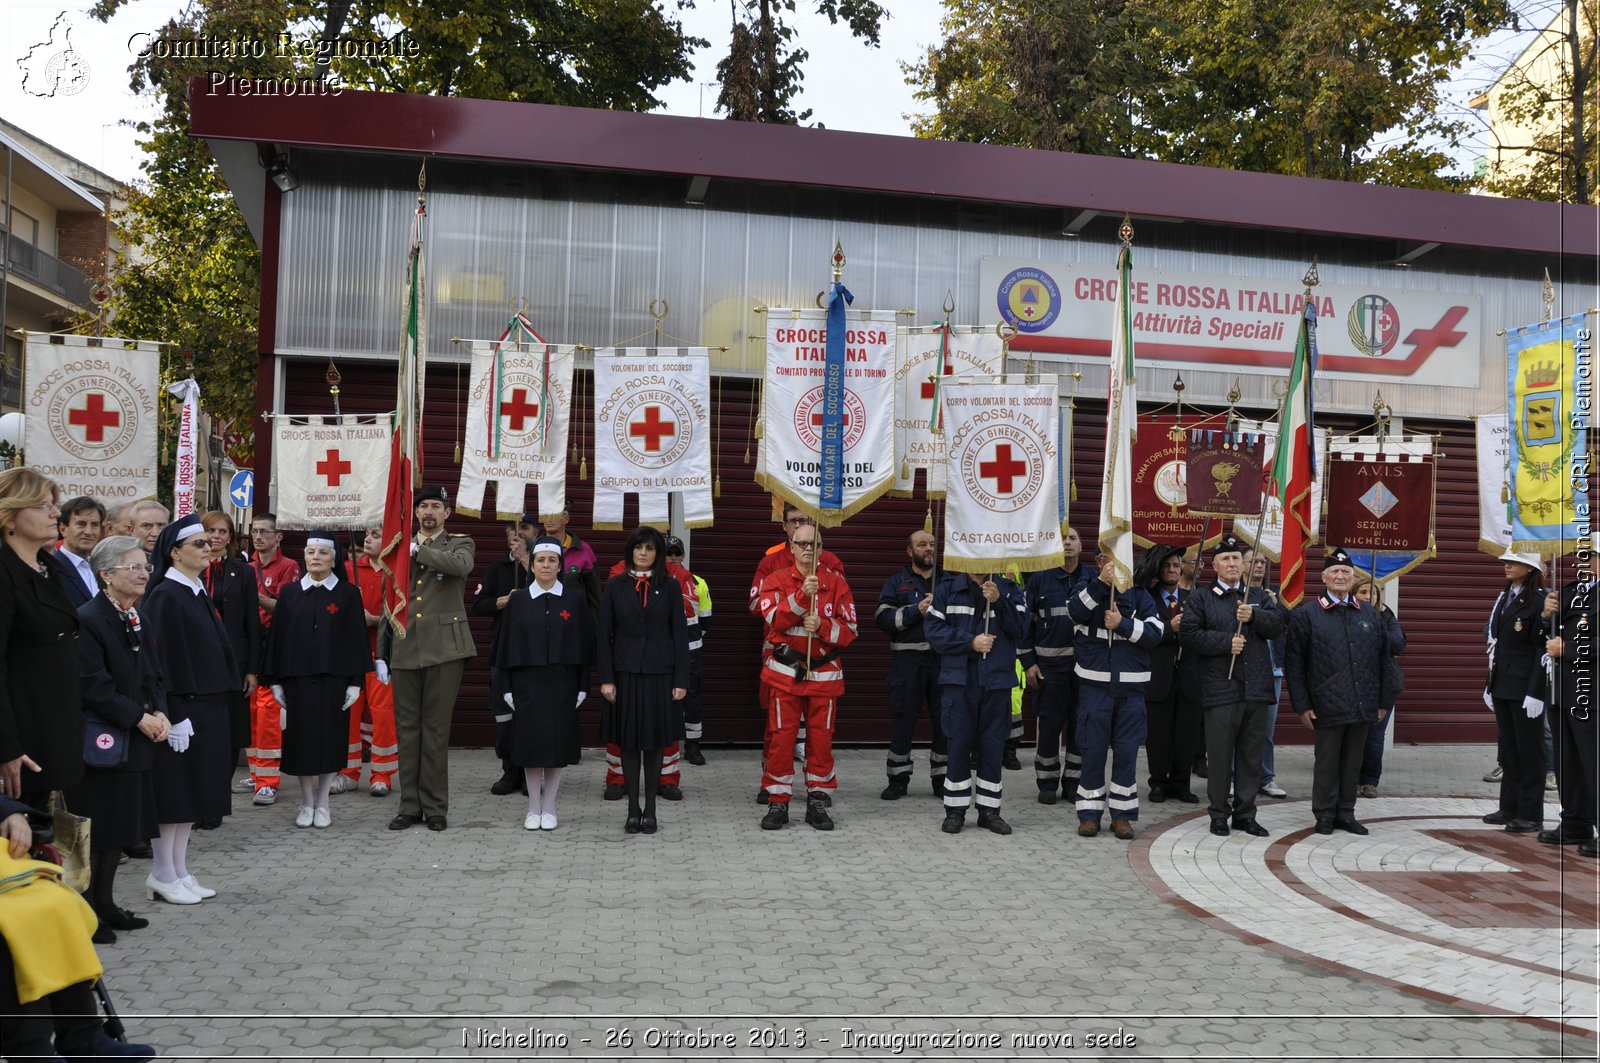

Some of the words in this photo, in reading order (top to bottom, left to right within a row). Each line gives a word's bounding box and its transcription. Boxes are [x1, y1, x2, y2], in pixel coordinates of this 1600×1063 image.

[1001, 275, 1017, 294] Croce
[1016, 271, 1039, 279] Rossa
[1040, 274, 1057, 298] Italiana
[1157, 283, 1231, 310] ROSSA
[1133, 311, 1202, 335] Attività
[1207, 316, 1285, 341] Speciali
[776, 328, 828, 344] CROCE
[845, 330, 887, 345] OSSA
[611, 364, 645, 373] VOLONTARI
[648, 364, 660, 372] DEL
[662, 364, 693, 372] SOCCORSO
[776, 366, 808, 377] COMITATO
[855, 369, 862, 378] DI
[864, 368, 887, 378] TORINO
[895, 355, 921, 381] CROCE
[30, 368, 64, 407] CROCE
[64, 359, 111, 375] ROSSA
[114, 365, 154, 415] ITALIANA
[65, 383, 77, 394] DI
[79, 378, 122, 395] GINEVRA
[507, 374, 541, 391] GINEVRA
[827, 364, 840, 416] SOCCORSO
[121, 396, 133, 410] 22
[599, 386, 626, 423] CROCE
[625, 375, 666, 391] ROSSA
[668, 378, 707, 422] ITALIANA
[626, 399, 637, 409] DI
[638, 391, 677, 407] GINEVRA
[847, 396, 858, 406] 22
[946, 397, 968, 407] CORPO
[970, 397, 1006, 407] VOLONTARI
[1009, 397, 1021, 406] DEL
[1024, 397, 1053, 407] SOCCORSO
[676, 406, 687, 418] 22
[796, 401, 818, 447] CONVENZIONE
[807, 393, 818, 404] DI
[852, 406, 864, 434] AGOSTO
[51, 394, 85, 456] CONVENZIONE
[121, 410, 137, 446] AGOSTO
[180, 403, 191, 448] ITALIANA
[826, 421, 838, 440] DEL
[280, 430, 311, 441] CROCE
[314, 430, 342, 441] ROSSA
[347, 429, 386, 440] ITALIANA
[616, 409, 645, 465] CONVENZIONE
[679, 419, 690, 450] AGOSTO
[948, 420, 974, 460] CROCE
[972, 408, 1014, 426] ROSSA
[1016, 412, 1057, 460] ITALIANA
[974, 435, 985, 446] DI
[987, 426, 1026, 444] GINEVRA
[661, 449, 681, 464] 1864
[1026, 443, 1038, 456] 22
[520, 453, 556, 463] LOCALE
[102, 467, 151, 478] LOCALE
[179, 453, 191, 486] ROSSA
[481, 467, 546, 480] MONCALIERI
[823, 444, 836, 500] VOLONTARI
[854, 462, 875, 473] DEL
[1029, 457, 1042, 492] AGOSTO
[1135, 451, 1163, 483] DONATORI
[1357, 465, 1406, 477] A.V.I.S.
[600, 476, 640, 487] GRUPPO
[643, 477, 652, 487] DI
[655, 477, 669, 487] LA
[671, 476, 706, 487] LOGGIA
[963, 447, 996, 508] CONVENZIONE
[59, 483, 138, 497] ARIGNANO
[306, 494, 337, 502] COMITATO
[338, 494, 362, 502] LOCALE
[1012, 490, 1033, 508] 1864
[306, 506, 362, 518] BORGOSESIA
[1132, 510, 1166, 519] GRUPPO
[1147, 522, 1204, 532] NICHELINO
[1356, 521, 1399, 530] SEZIONE
[952, 531, 1035, 544] CASTAGNOLE
[1037, 531, 1056, 542] P.te
[1344, 536, 1409, 547] NICHELINO
